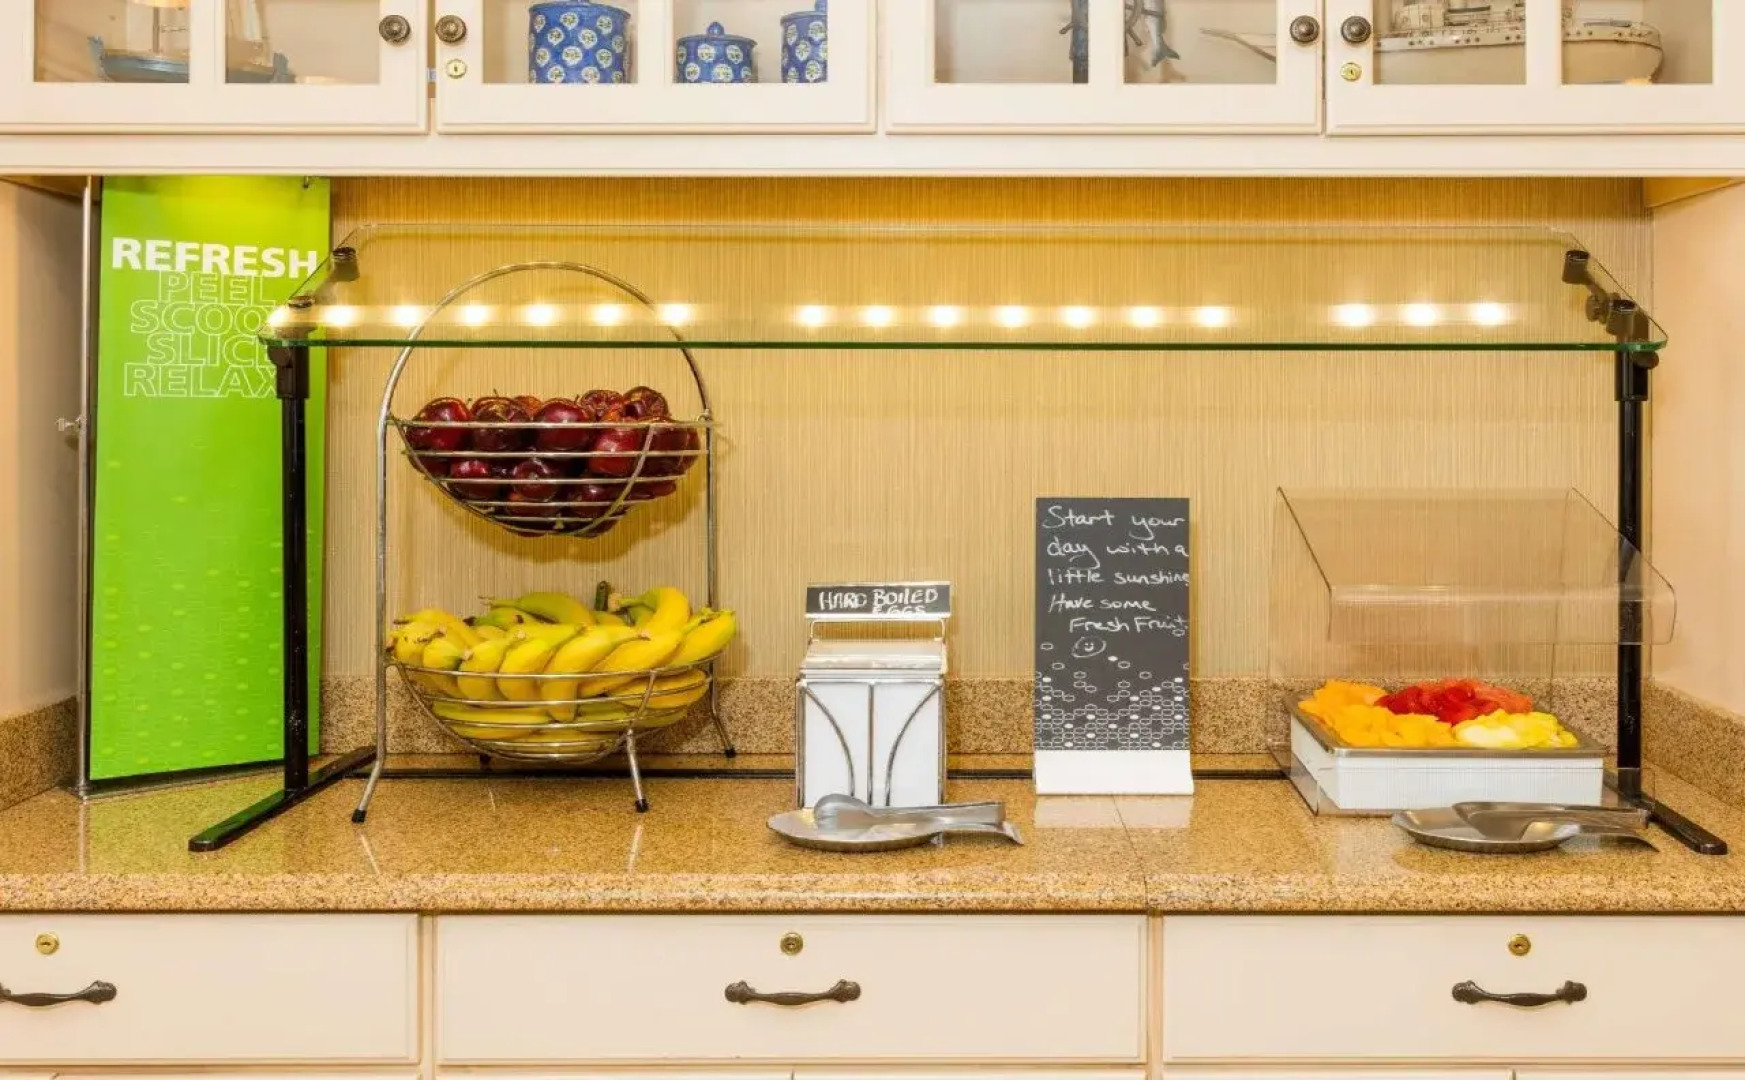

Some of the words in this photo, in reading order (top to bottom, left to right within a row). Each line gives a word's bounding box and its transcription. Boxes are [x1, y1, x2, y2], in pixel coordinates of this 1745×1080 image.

[112, 237, 317, 278] REFRESH
[158, 270, 276, 306] PEEL
[130, 299, 268, 336] SCOO
[123, 362, 277, 398] RELAX
[1042, 505, 1115, 529] Start
[1129, 515, 1185, 541] your
[1046, 536, 1101, 570] day
[1106, 542, 1169, 556] with
[1048, 568, 1104, 585] little
[818, 591, 868, 611] HARD
[1048, 592, 1094, 613] Have
[1100, 598, 1156, 612] some
[1069, 617, 1130, 633] Fresh
